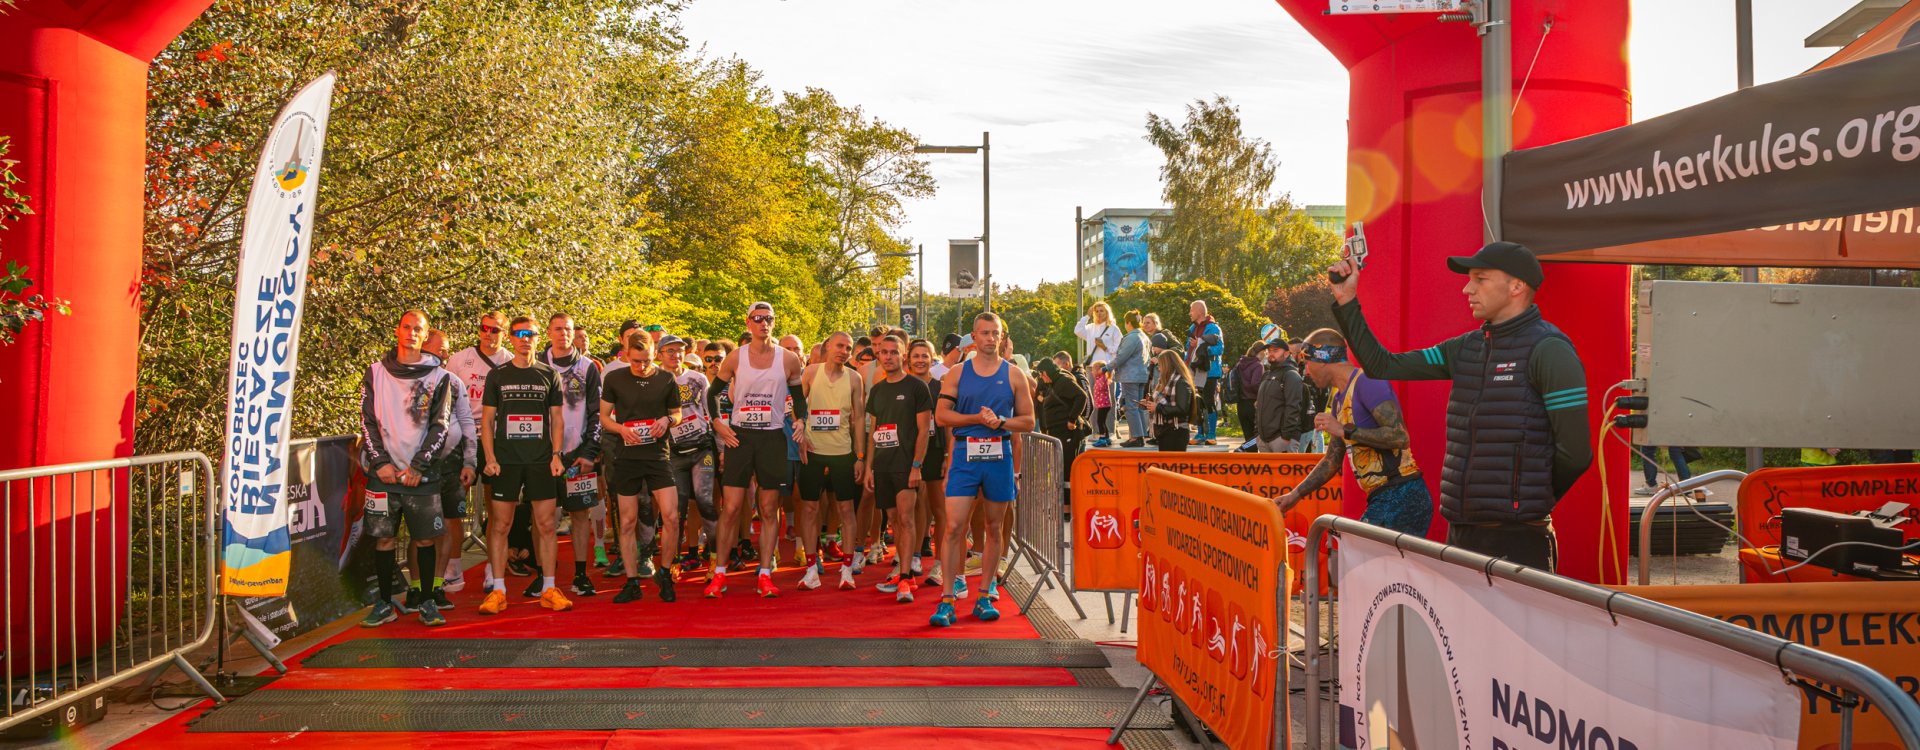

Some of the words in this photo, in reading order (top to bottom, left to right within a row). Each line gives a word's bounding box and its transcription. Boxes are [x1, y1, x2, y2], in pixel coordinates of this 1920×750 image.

[746, 413, 764, 422] 231
[816, 416, 834, 425] 300
[519, 423, 532, 432] 63
[638, 427, 651, 437] 22
[677, 422, 695, 435] 335
[877, 431, 891, 441] 276
[979, 444, 992, 454] 57
[574, 480, 592, 491] 305
[1821, 478, 1920, 498] KOMPLEK
[1160, 488, 1209, 525] KOMPLEKSOWA
[1209, 504, 1270, 552] ORGANIZACJA
[1166, 525, 1202, 562] WYDARZEŃ
[1203, 542, 1259, 592] SPORTOWYCH
[1373, 582, 1428, 611] STOWARZYSZENIE
[1428, 606, 1454, 662] BIEGÓW
